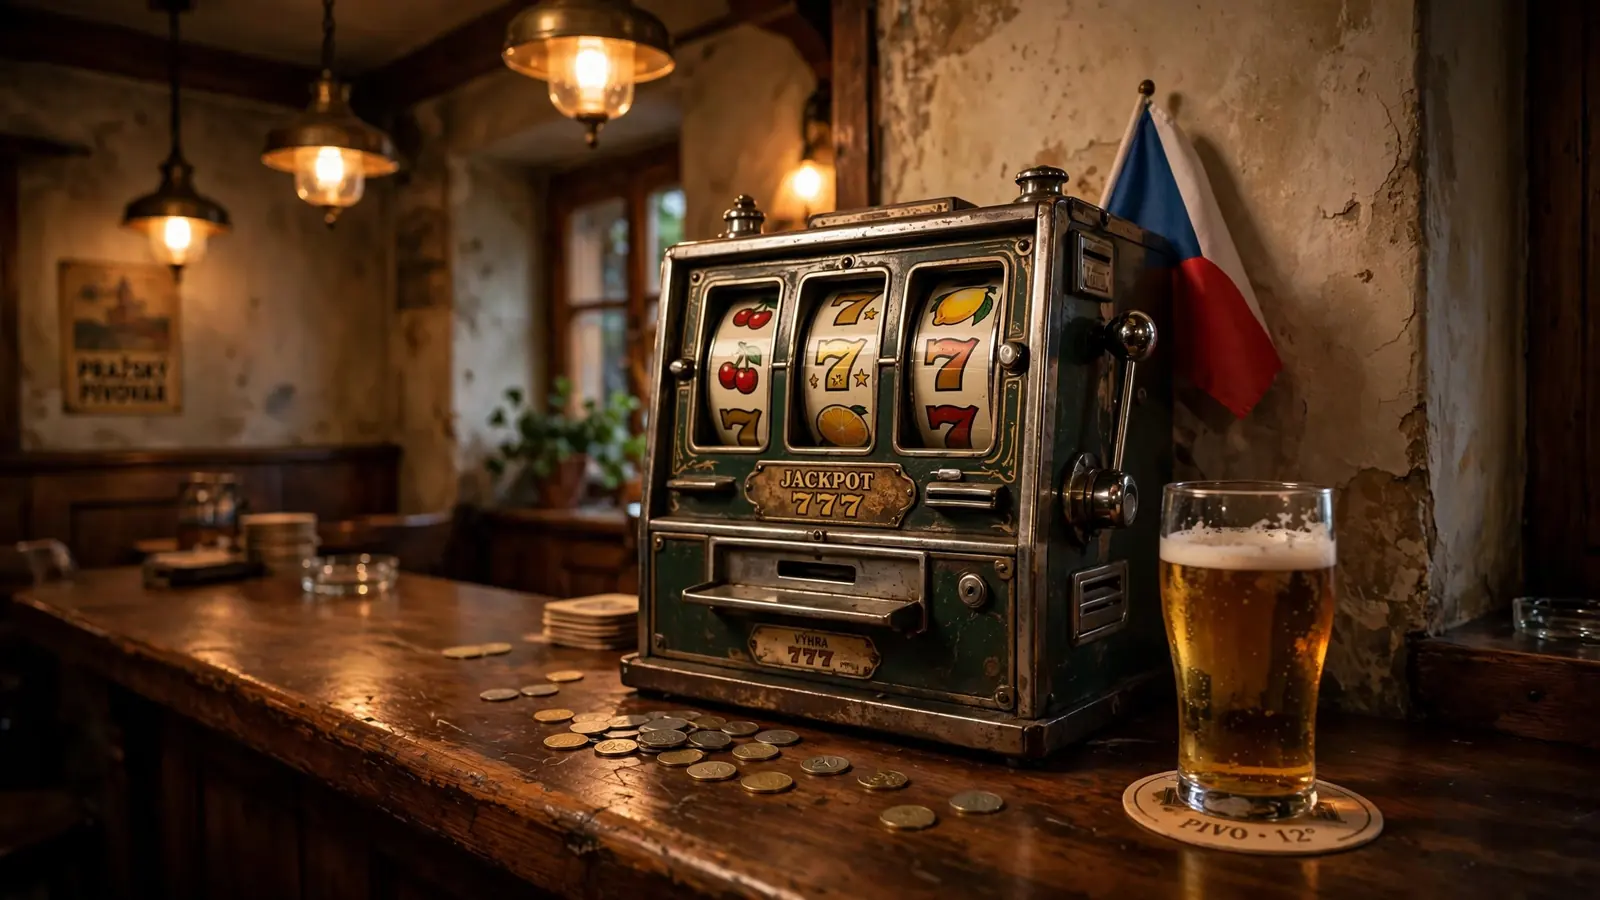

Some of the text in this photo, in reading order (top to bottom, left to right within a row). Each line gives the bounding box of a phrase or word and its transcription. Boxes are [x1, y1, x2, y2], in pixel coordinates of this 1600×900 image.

[815, 338, 868, 391] 7
[924, 337, 980, 391] 7
[780, 469, 874, 490] JACKPOT
[791, 491, 864, 517] 777
[794, 632, 829, 648] VÝHRA
[788, 646, 834, 667] 777
[1179, 817, 1249, 840] PIVO
[1275, 827, 1315, 843] 12°
